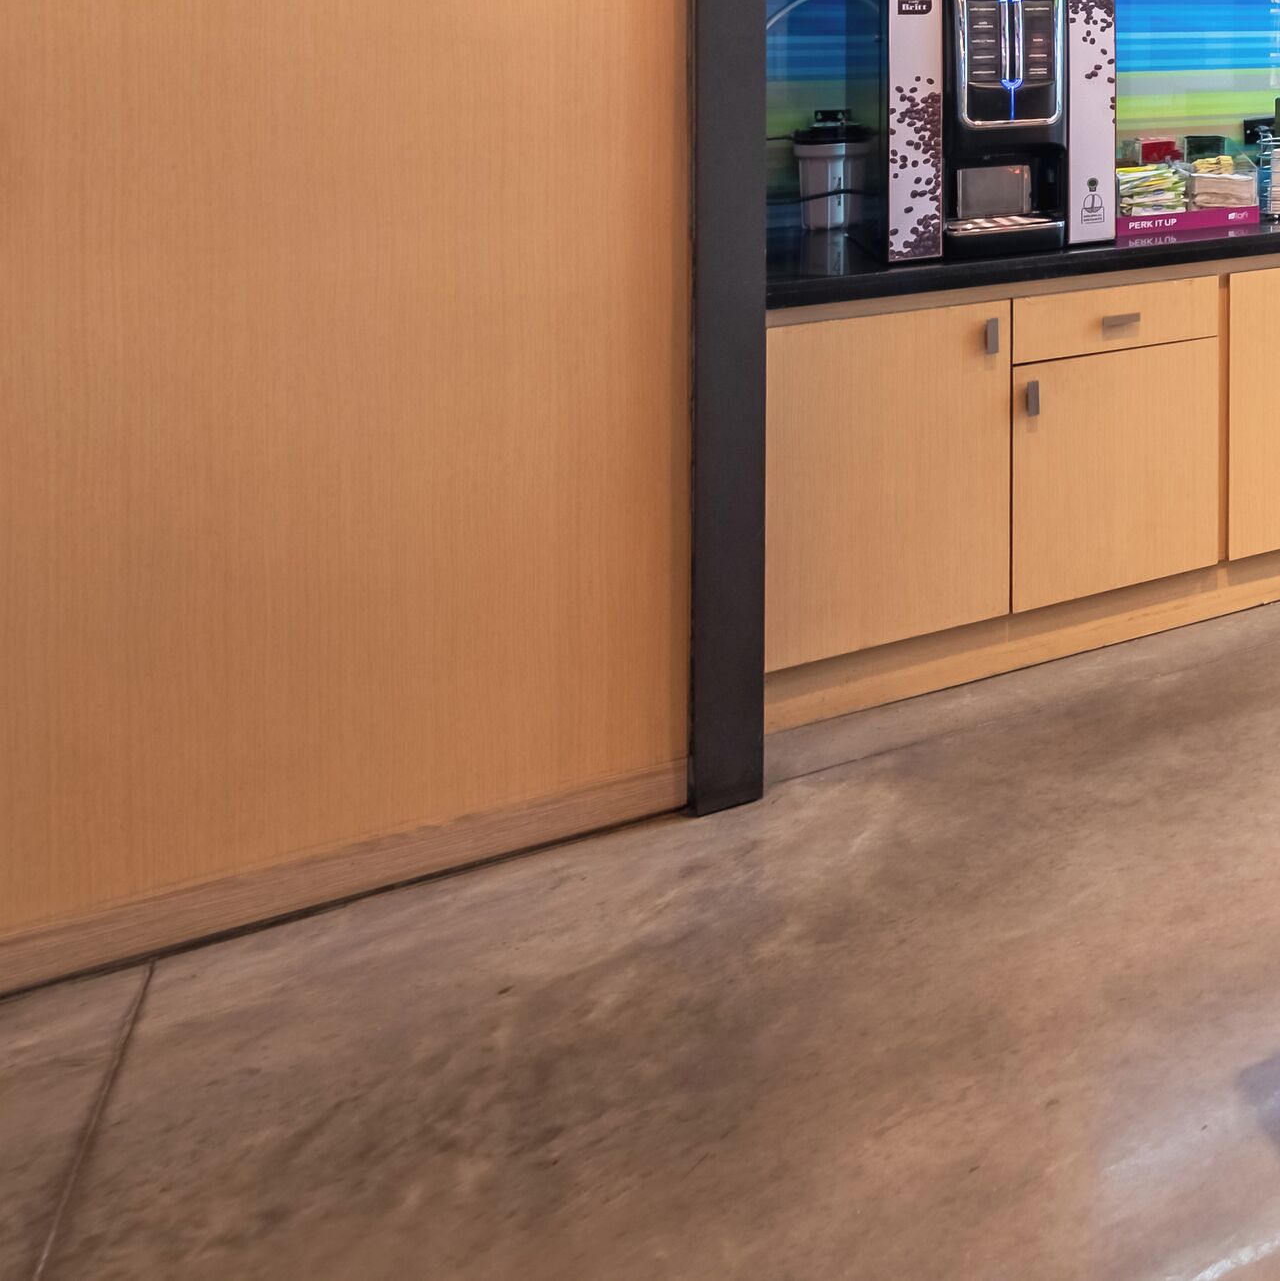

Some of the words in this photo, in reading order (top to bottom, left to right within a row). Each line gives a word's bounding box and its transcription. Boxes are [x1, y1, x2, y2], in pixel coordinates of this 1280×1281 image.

[1129, 220, 1154, 230] PERK
[1155, 219, 1164, 228] IT
[1164, 218, 1178, 227] UP
